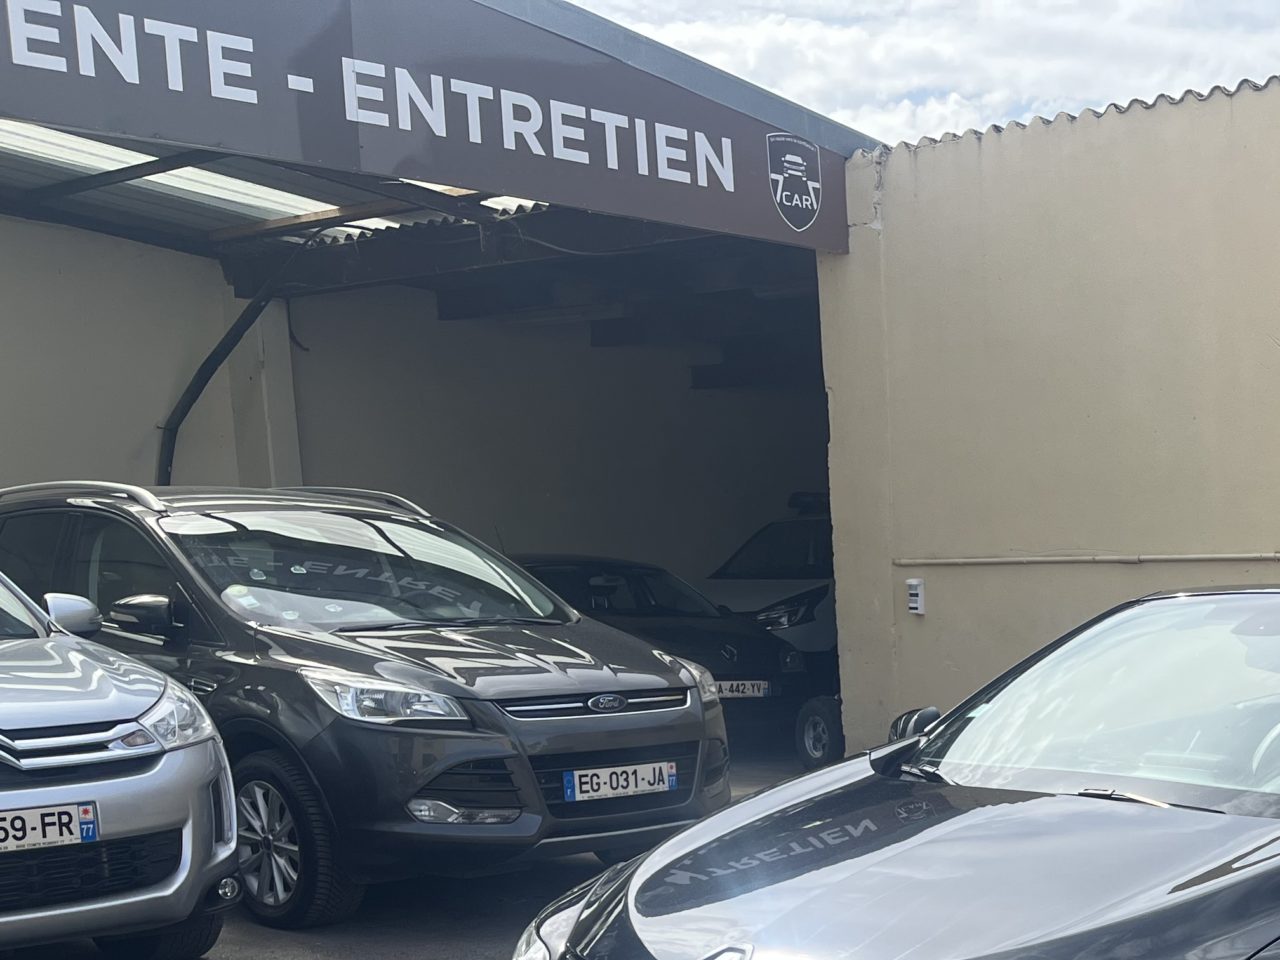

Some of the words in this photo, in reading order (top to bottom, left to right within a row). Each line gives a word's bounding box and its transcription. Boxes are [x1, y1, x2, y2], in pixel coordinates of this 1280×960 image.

[288, 75, 313, 92] -
[342, 57, 734, 192] ENTRETIEN
[598, 696, 619, 708] Ford
[578, 765, 665, 794] EG-031-JA
[81, 824, 93, 837] 77
